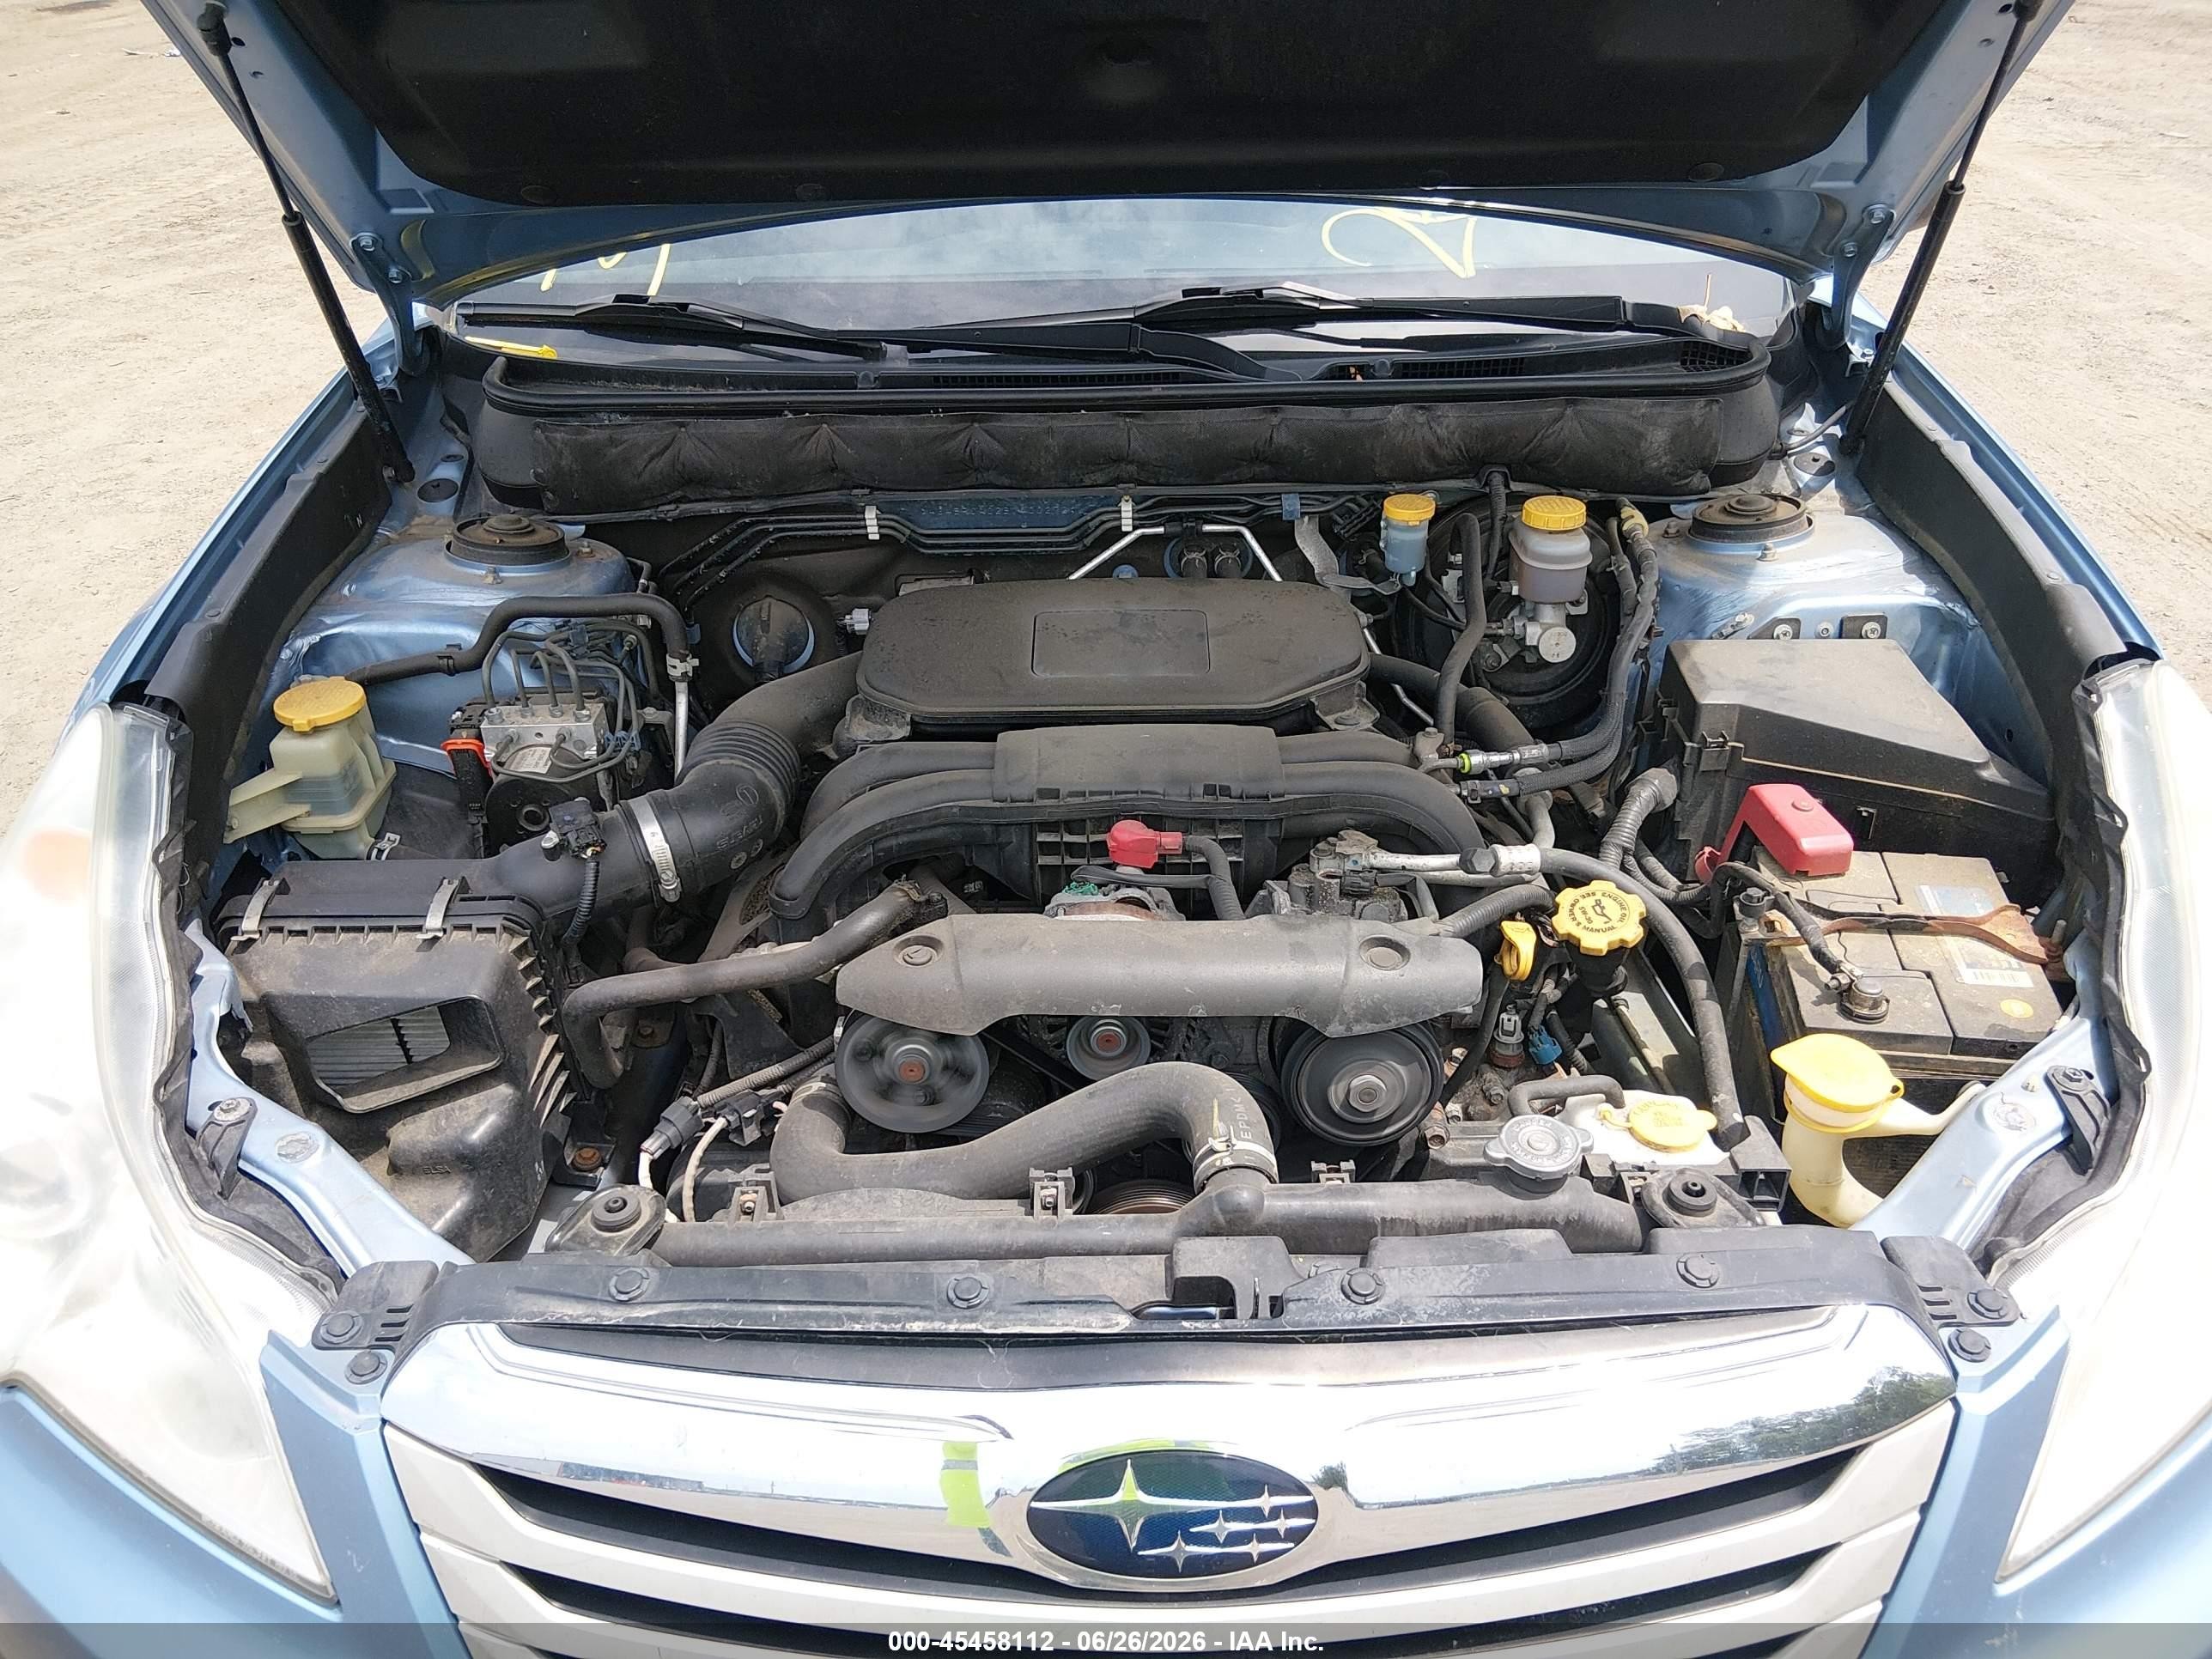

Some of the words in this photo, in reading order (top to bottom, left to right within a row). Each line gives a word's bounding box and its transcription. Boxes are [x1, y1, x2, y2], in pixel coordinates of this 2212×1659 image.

[1582, 891, 1596, 900] SEE
[1601, 891, 1627, 912] ENGINE
[1617, 913, 1627, 924] OIL
[1578, 906, 1594, 925] 5W-30
[1583, 924, 1617, 933] MANUAL
